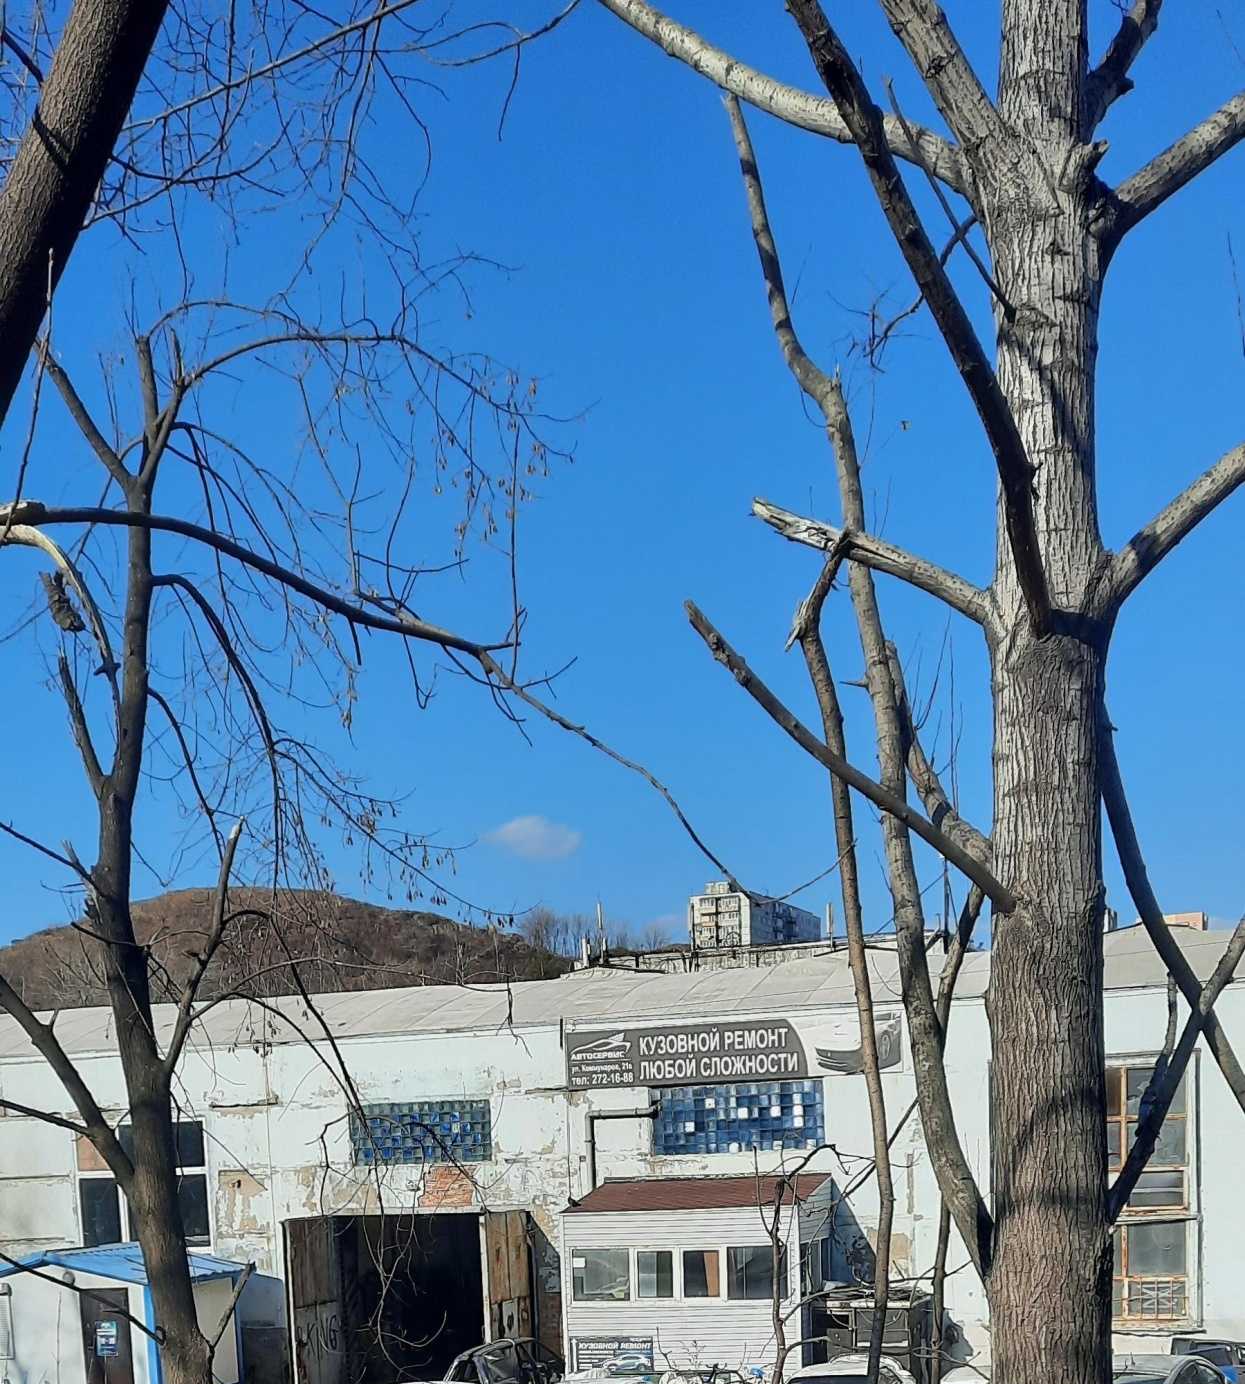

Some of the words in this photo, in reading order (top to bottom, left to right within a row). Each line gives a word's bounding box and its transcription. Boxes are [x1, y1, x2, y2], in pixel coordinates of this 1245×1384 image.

[639, 1027, 720, 1055] КУЗОВНОЙ
[724, 1028, 788, 1050] РЕМОНТ
[571, 1051, 625, 1060] АВТОСЕРВИС
[639, 1053, 697, 1080] ЛЮБОЙ
[700, 1052, 798, 1076] СЛОЖНОСТИ
[592, 1072, 634, 1085] 272-16-88
